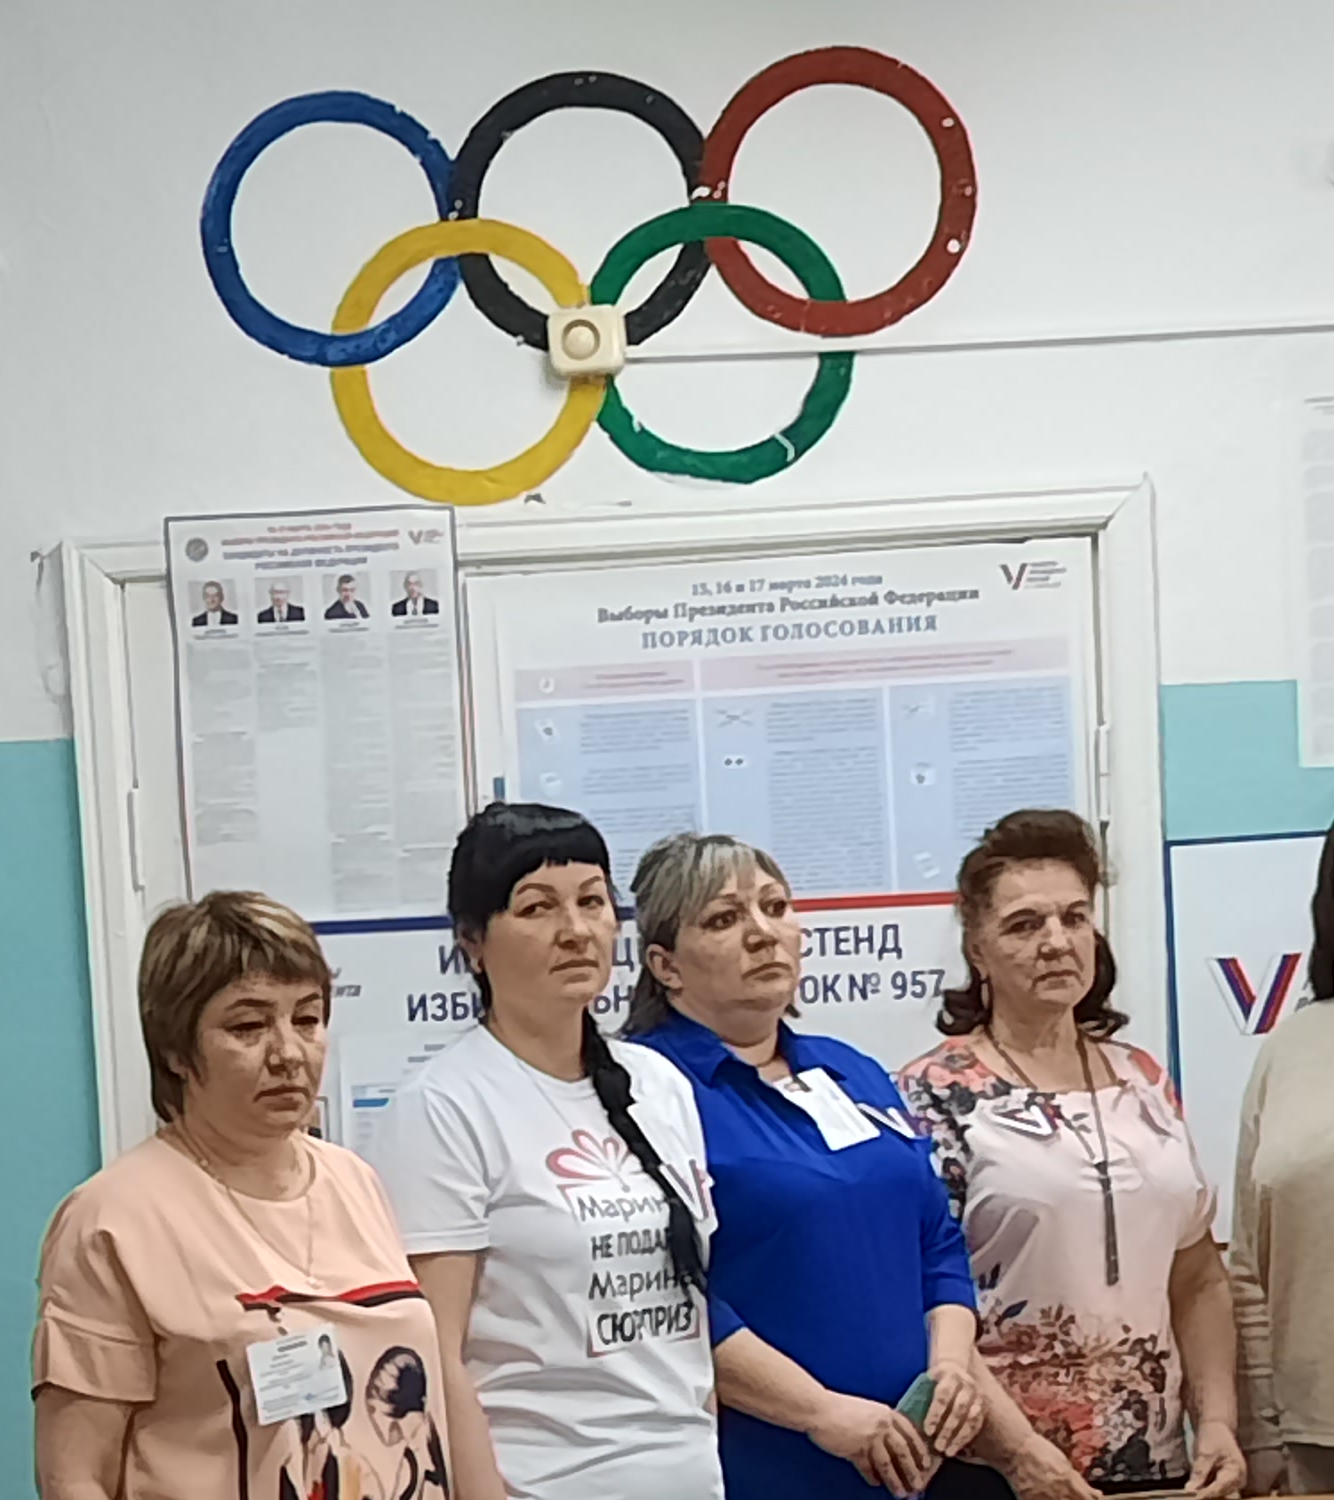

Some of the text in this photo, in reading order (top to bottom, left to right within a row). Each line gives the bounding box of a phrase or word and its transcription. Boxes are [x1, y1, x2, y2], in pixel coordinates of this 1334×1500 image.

[597, 605, 669, 625] Выборы
[641, 614, 938, 650] ПОРЯДОК ГОЛОСОВАНИЯ
[890, 968, 946, 1000] 957
[591, 1234, 615, 1261] НЕ
